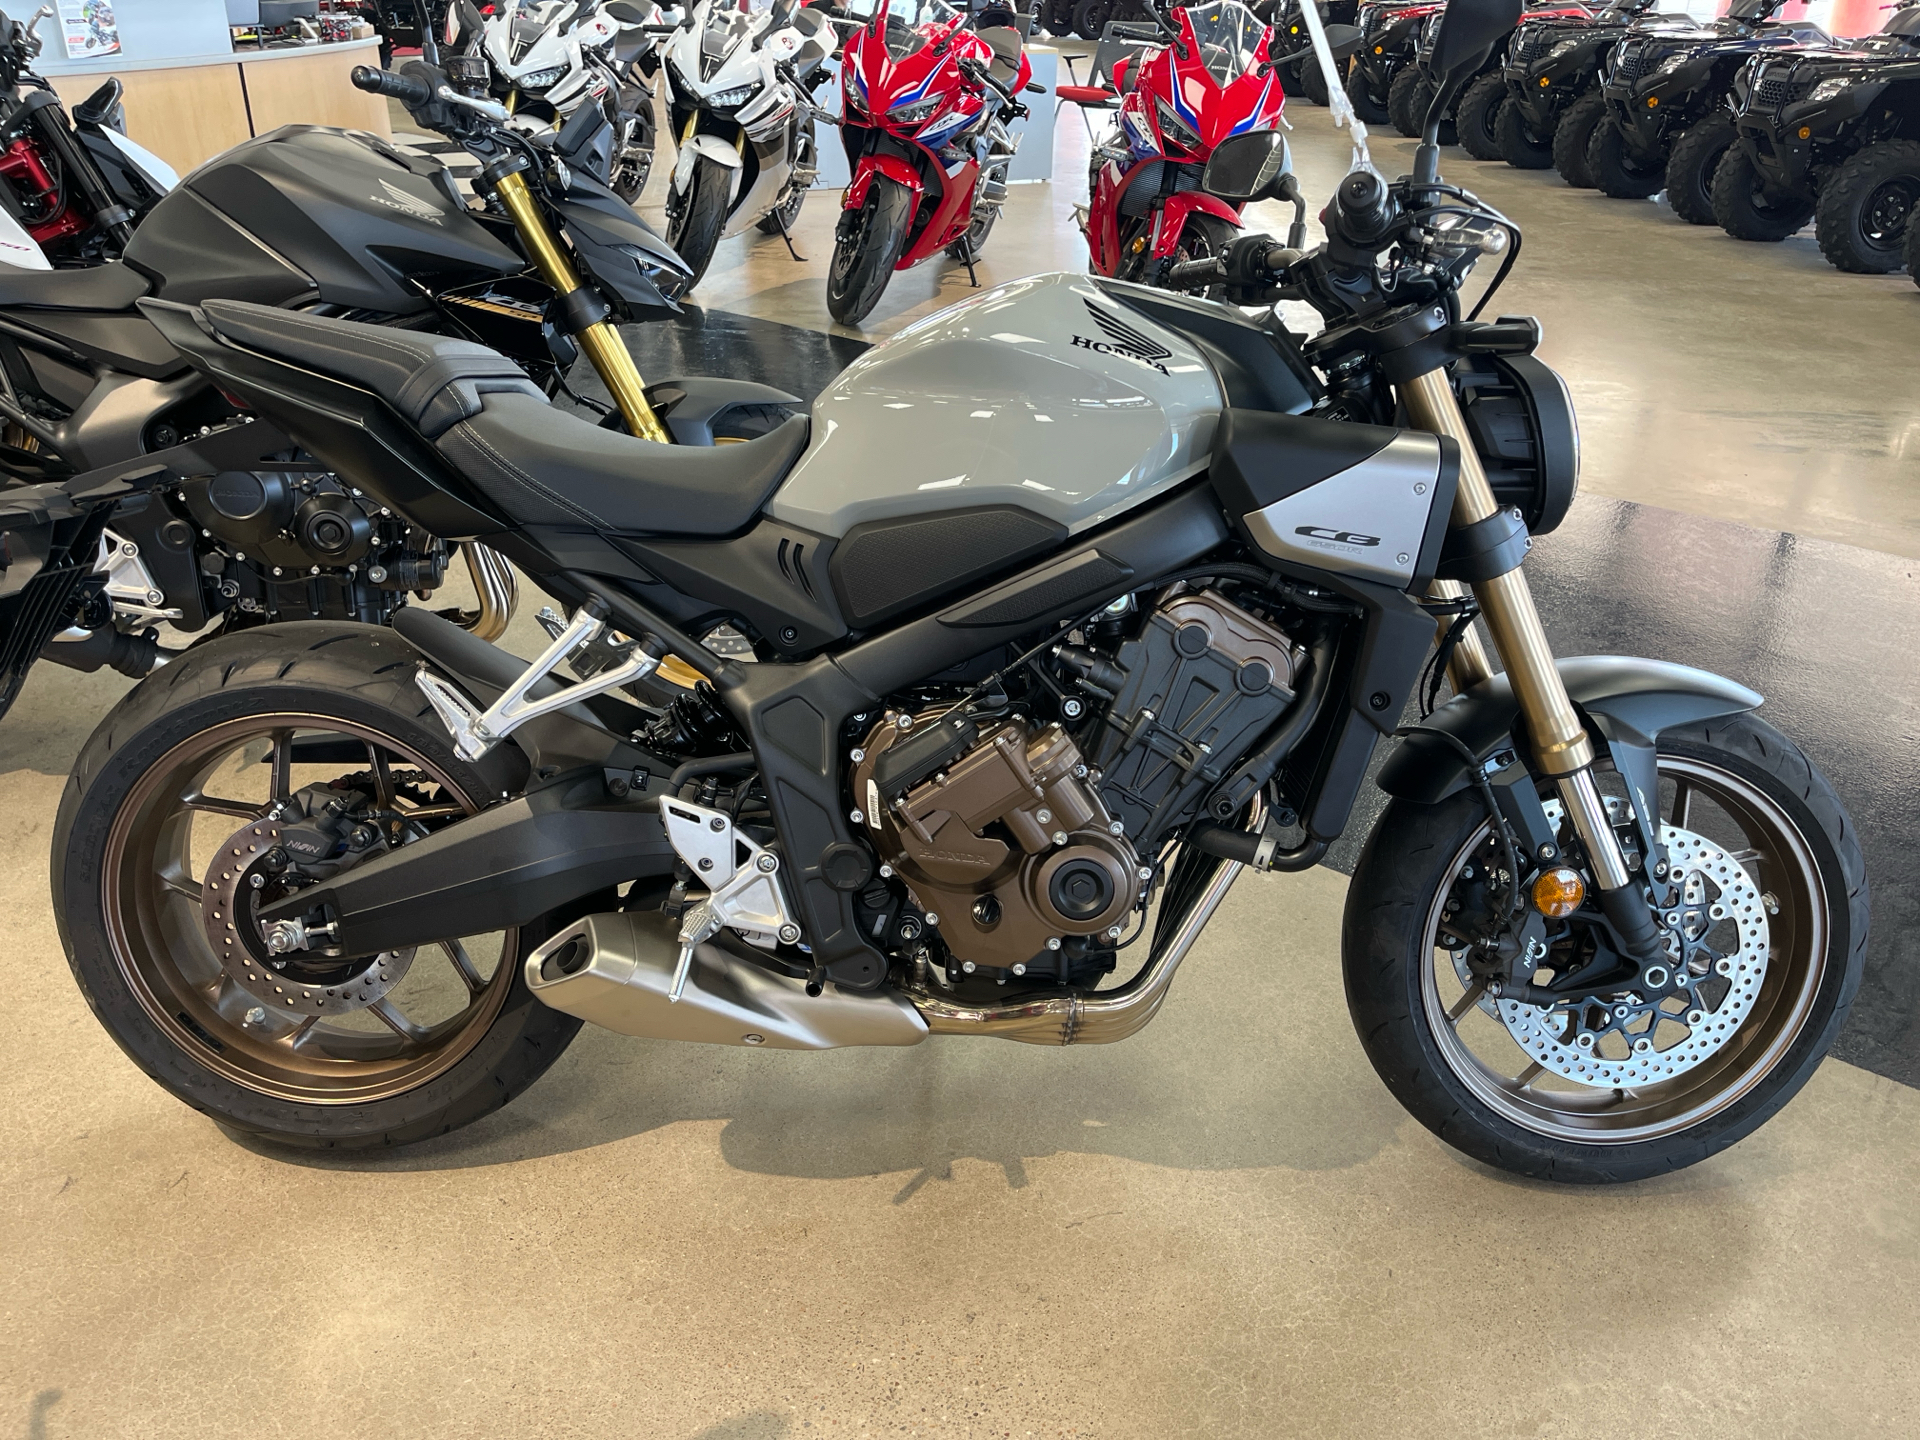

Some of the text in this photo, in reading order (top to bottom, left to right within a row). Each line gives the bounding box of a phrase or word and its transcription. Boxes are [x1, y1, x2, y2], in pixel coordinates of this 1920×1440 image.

[369, 195, 443, 227] HONDA
[1070, 335, 1171, 378] HONDA
[1294, 526, 1381, 546] CB
[919, 848, 991, 866] HONDA
